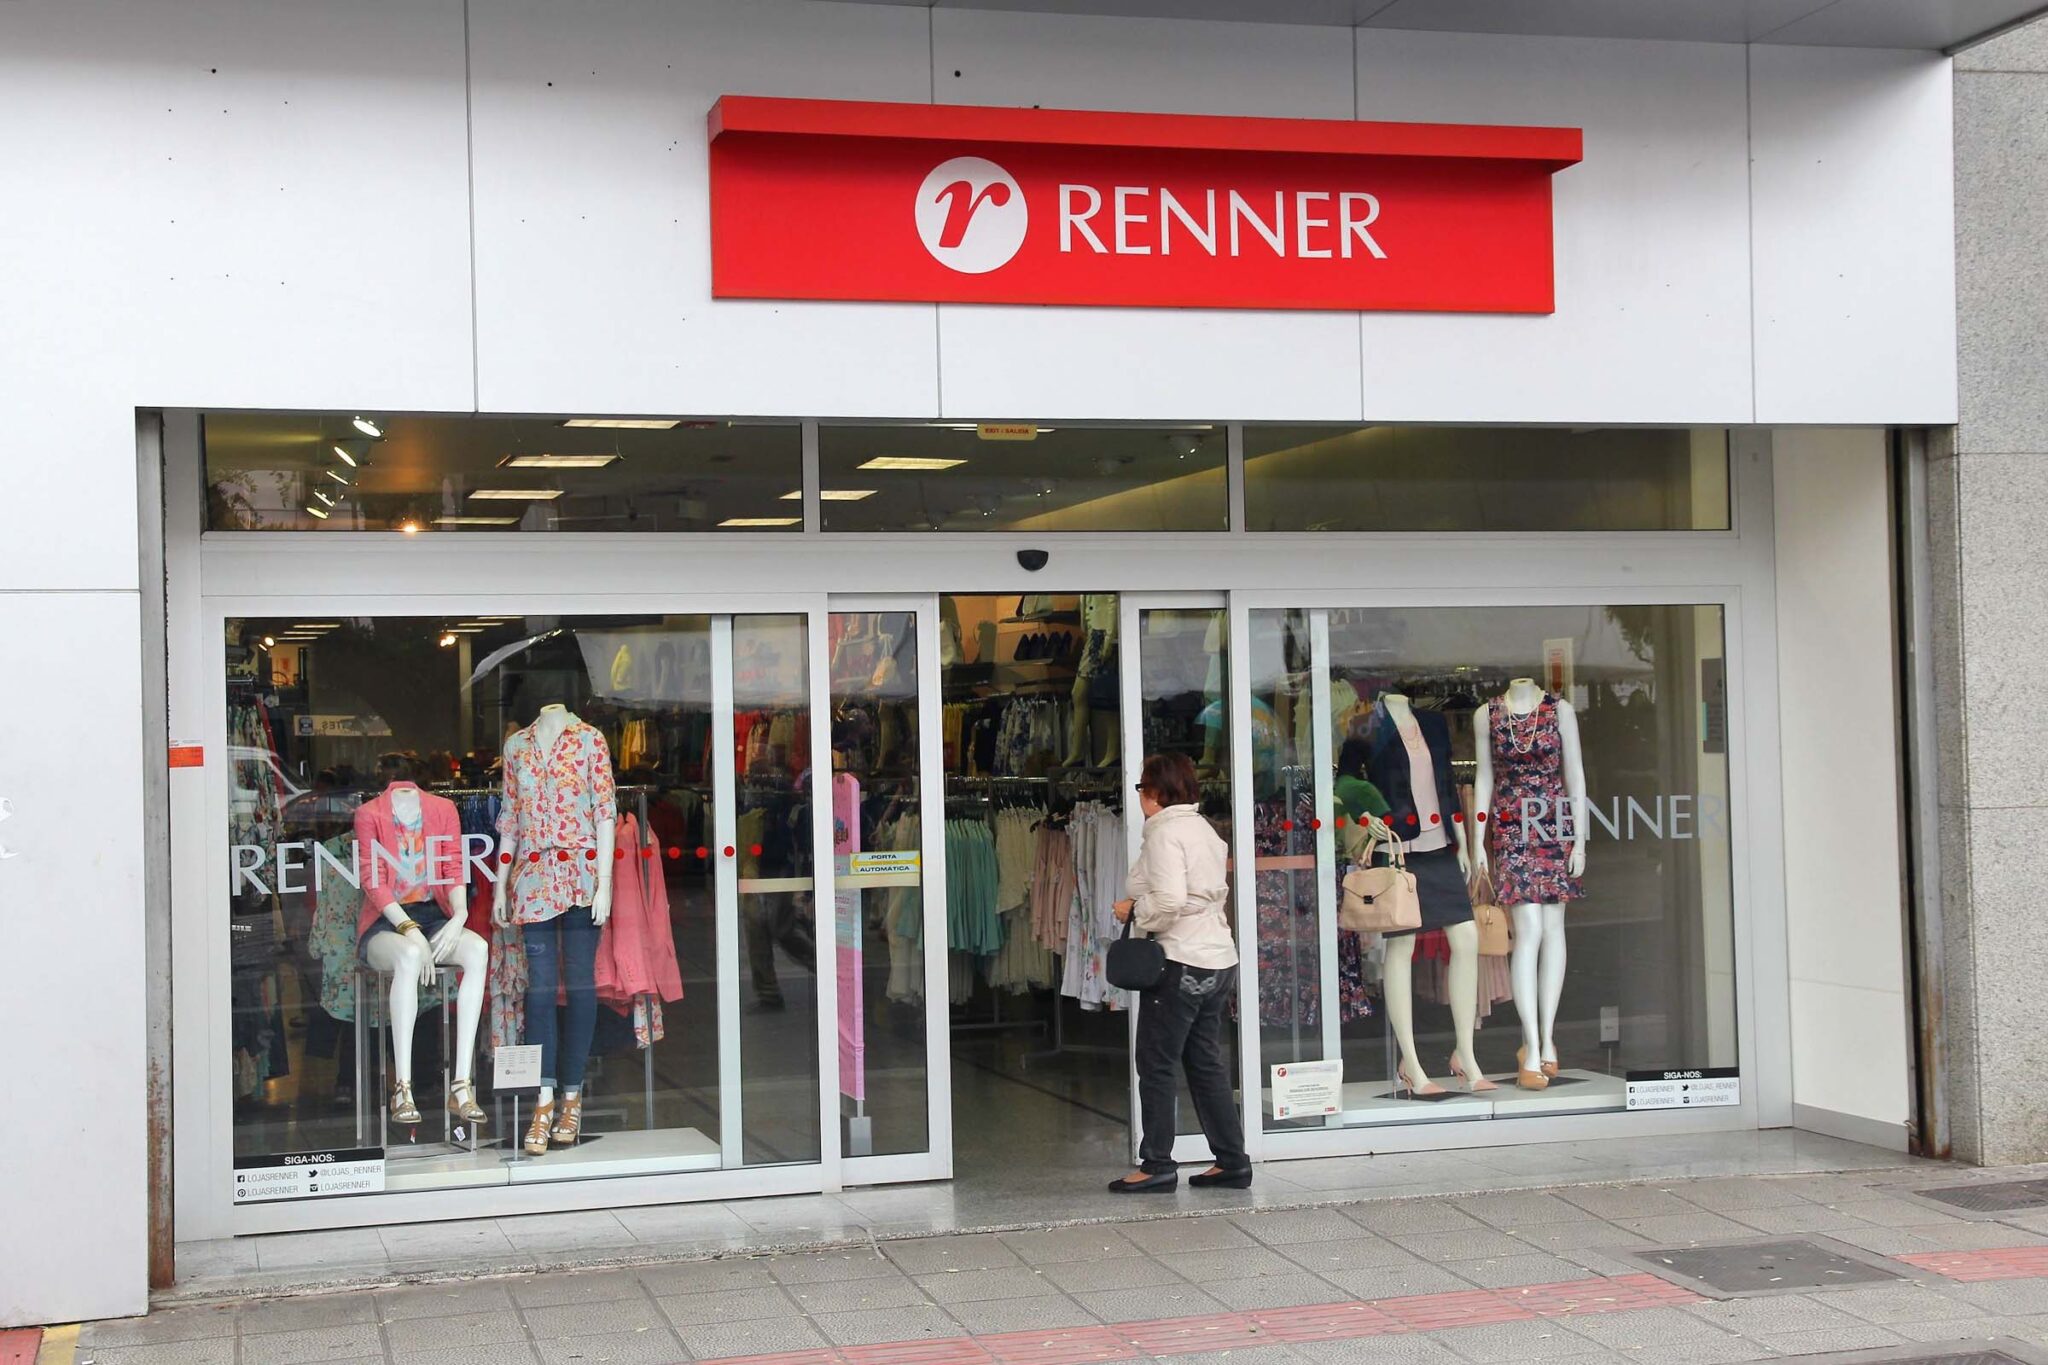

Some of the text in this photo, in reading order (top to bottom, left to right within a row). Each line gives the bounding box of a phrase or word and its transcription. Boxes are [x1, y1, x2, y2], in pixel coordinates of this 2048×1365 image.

[1059, 183, 1388, 260] RENNER
[1520, 794, 1724, 843] RENNER
[231, 833, 499, 897] RENNER
[1663, 1070, 1702, 1080] SIGA-NOS:
[284, 1153, 336, 1165] SIGA-NOS:
[320, 1165, 382, 1177] @LOJAS_RENNER
[247, 1172, 298, 1183] LOJASRENNER
[247, 1186, 298, 1197] LOJASRENNER
[320, 1181, 370, 1192] LOJASRENNER
